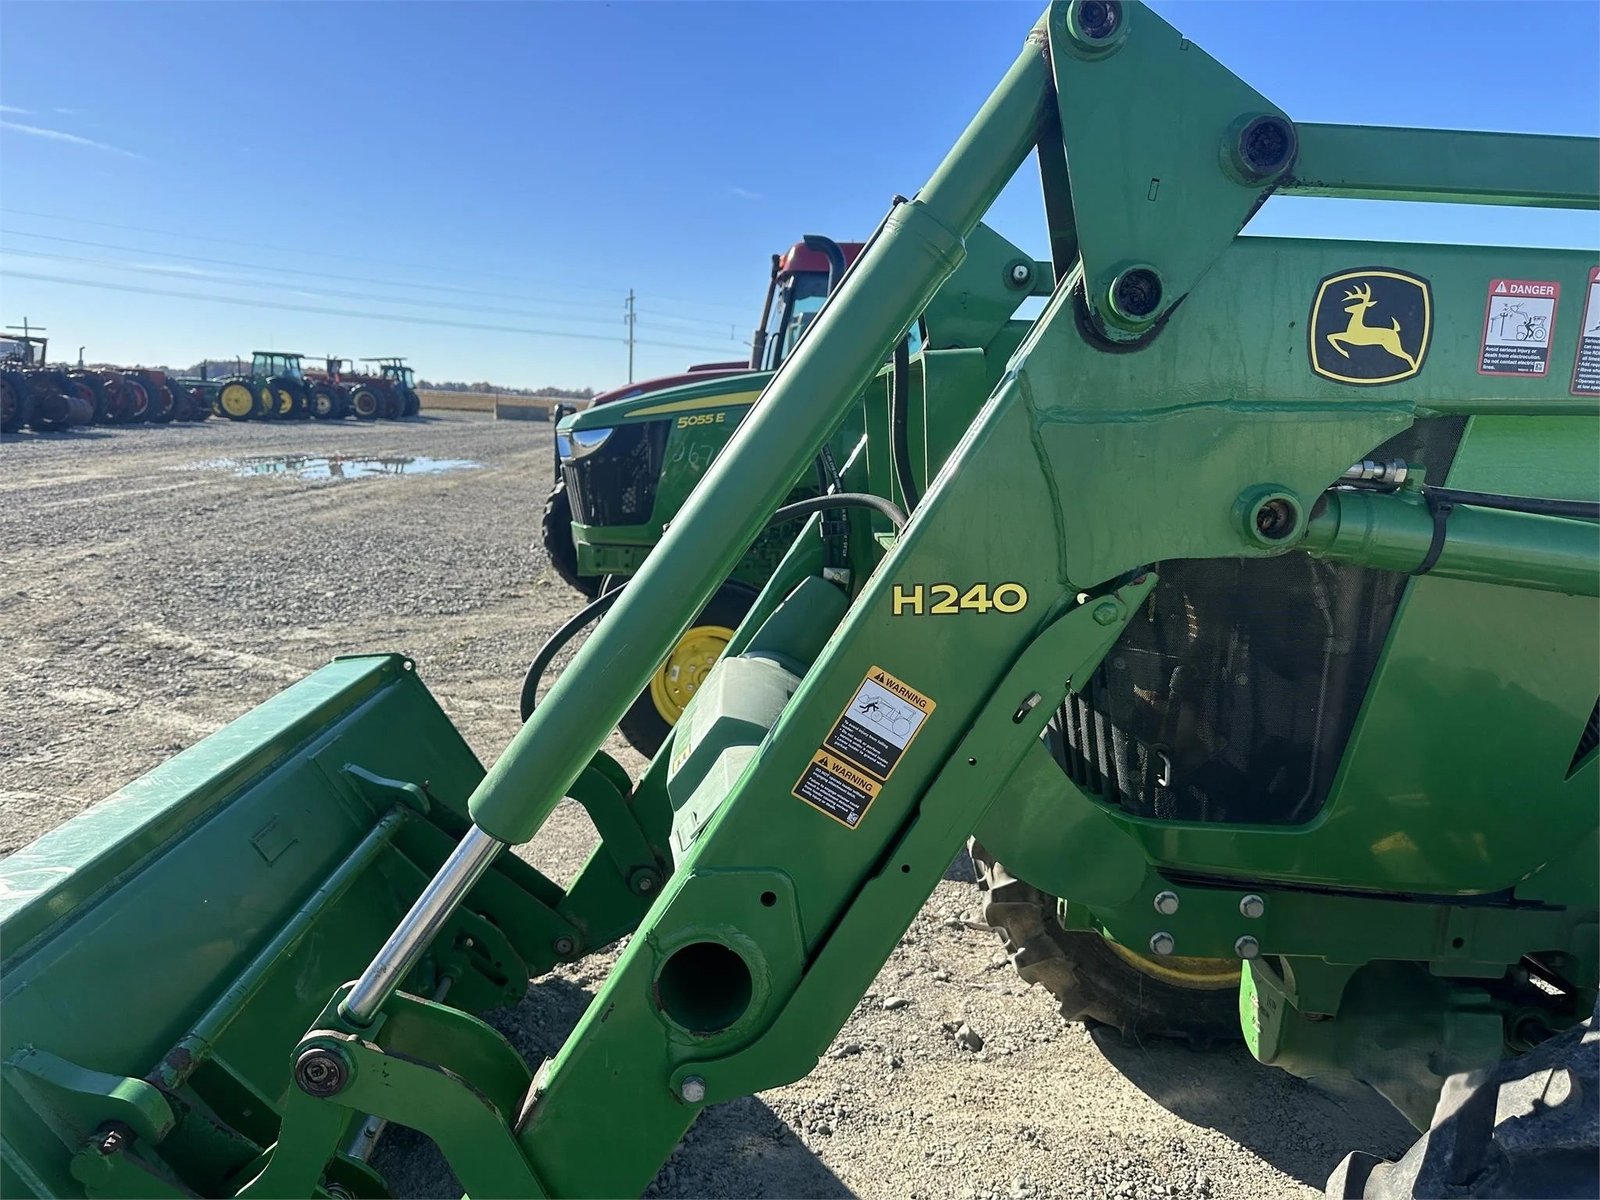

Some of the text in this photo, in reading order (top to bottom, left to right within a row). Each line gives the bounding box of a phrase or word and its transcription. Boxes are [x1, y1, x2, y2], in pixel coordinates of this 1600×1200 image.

[1510, 284, 1554, 296] DANGER
[892, 582, 1028, 616] H240
[886, 678, 927, 708] WARNING
[832, 762, 873, 792] WARNING
